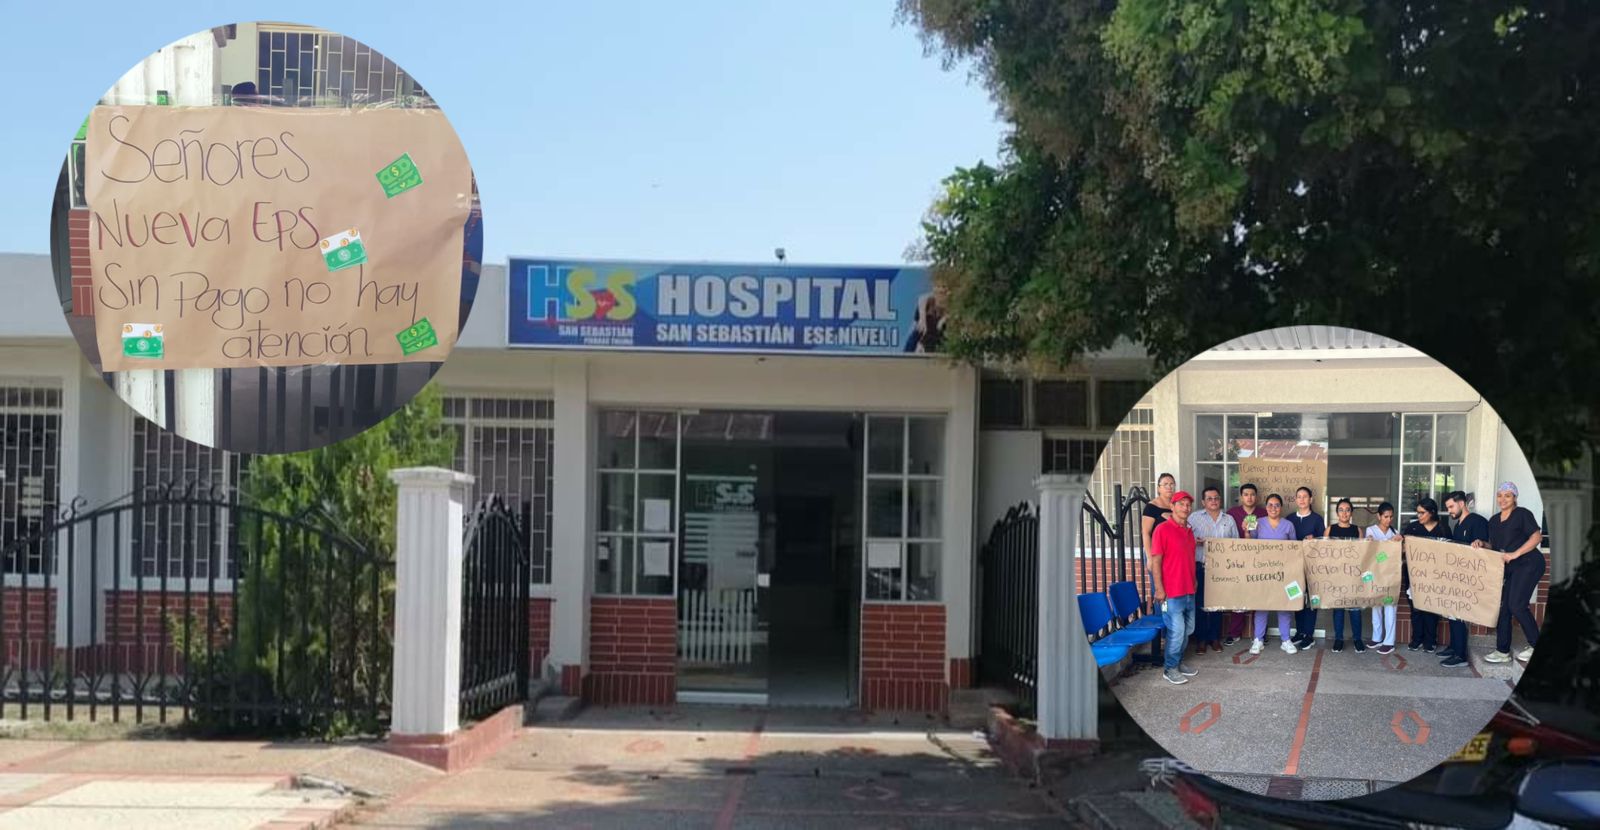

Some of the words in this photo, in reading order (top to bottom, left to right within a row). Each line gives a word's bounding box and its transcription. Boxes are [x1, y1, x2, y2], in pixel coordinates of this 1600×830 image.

[101, 114, 310, 186] Señores
[95, 198, 231, 250] Nueva
[252, 201, 320, 251] EPS
[98, 262, 159, 311] Sin
[168, 271, 269, 330] Pago
[284, 276, 331, 311] no
[356, 263, 419, 324] hay
[656, 274, 897, 320] HOSPITAL
[558, 325, 578, 336] SAN
[656, 323, 693, 343] SAN
[696, 322, 795, 345] SEBASTIÁN
[803, 326, 836, 345] ESE
[838, 326, 889, 347] NIVEL
[1292, 464, 1303, 473] de
[1287, 542, 1299, 551] de
[1306, 544, 1360, 560] Señores
[1409, 545, 1436, 564] VIDA
[1446, 552, 1488, 574] DIGNA
[1351, 584, 1365, 594] no
[1410, 566, 1427, 578] CON
[1433, 569, 1485, 591] SALARIOS
[1418, 582, 1479, 605] HONORARIOS
[1424, 595, 1432, 606] A
[1435, 597, 1472, 613] TIEMPO
